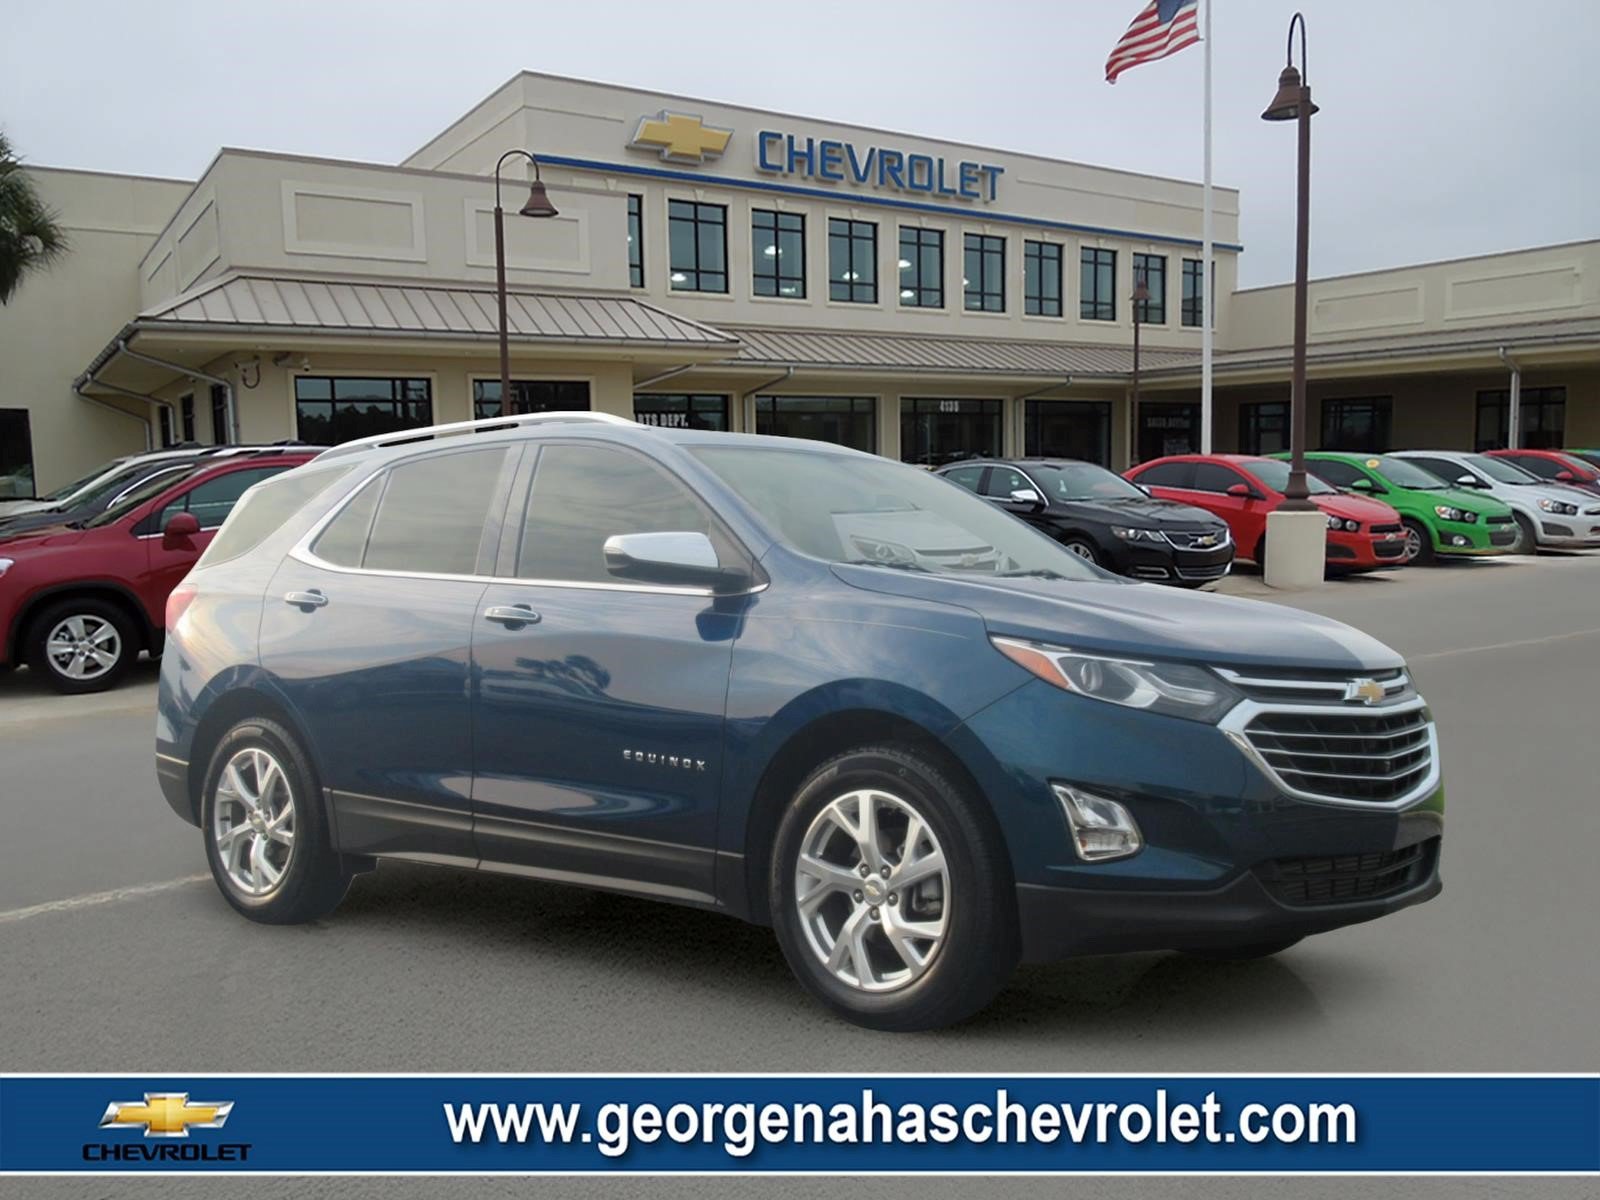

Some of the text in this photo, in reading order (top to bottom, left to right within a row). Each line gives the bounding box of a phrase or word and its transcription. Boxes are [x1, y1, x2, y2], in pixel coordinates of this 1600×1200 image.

[756, 130, 1005, 202] CHEVROLET
[635, 413, 689, 427] RTS DEPT.
[623, 749, 706, 771] EQUINOX
